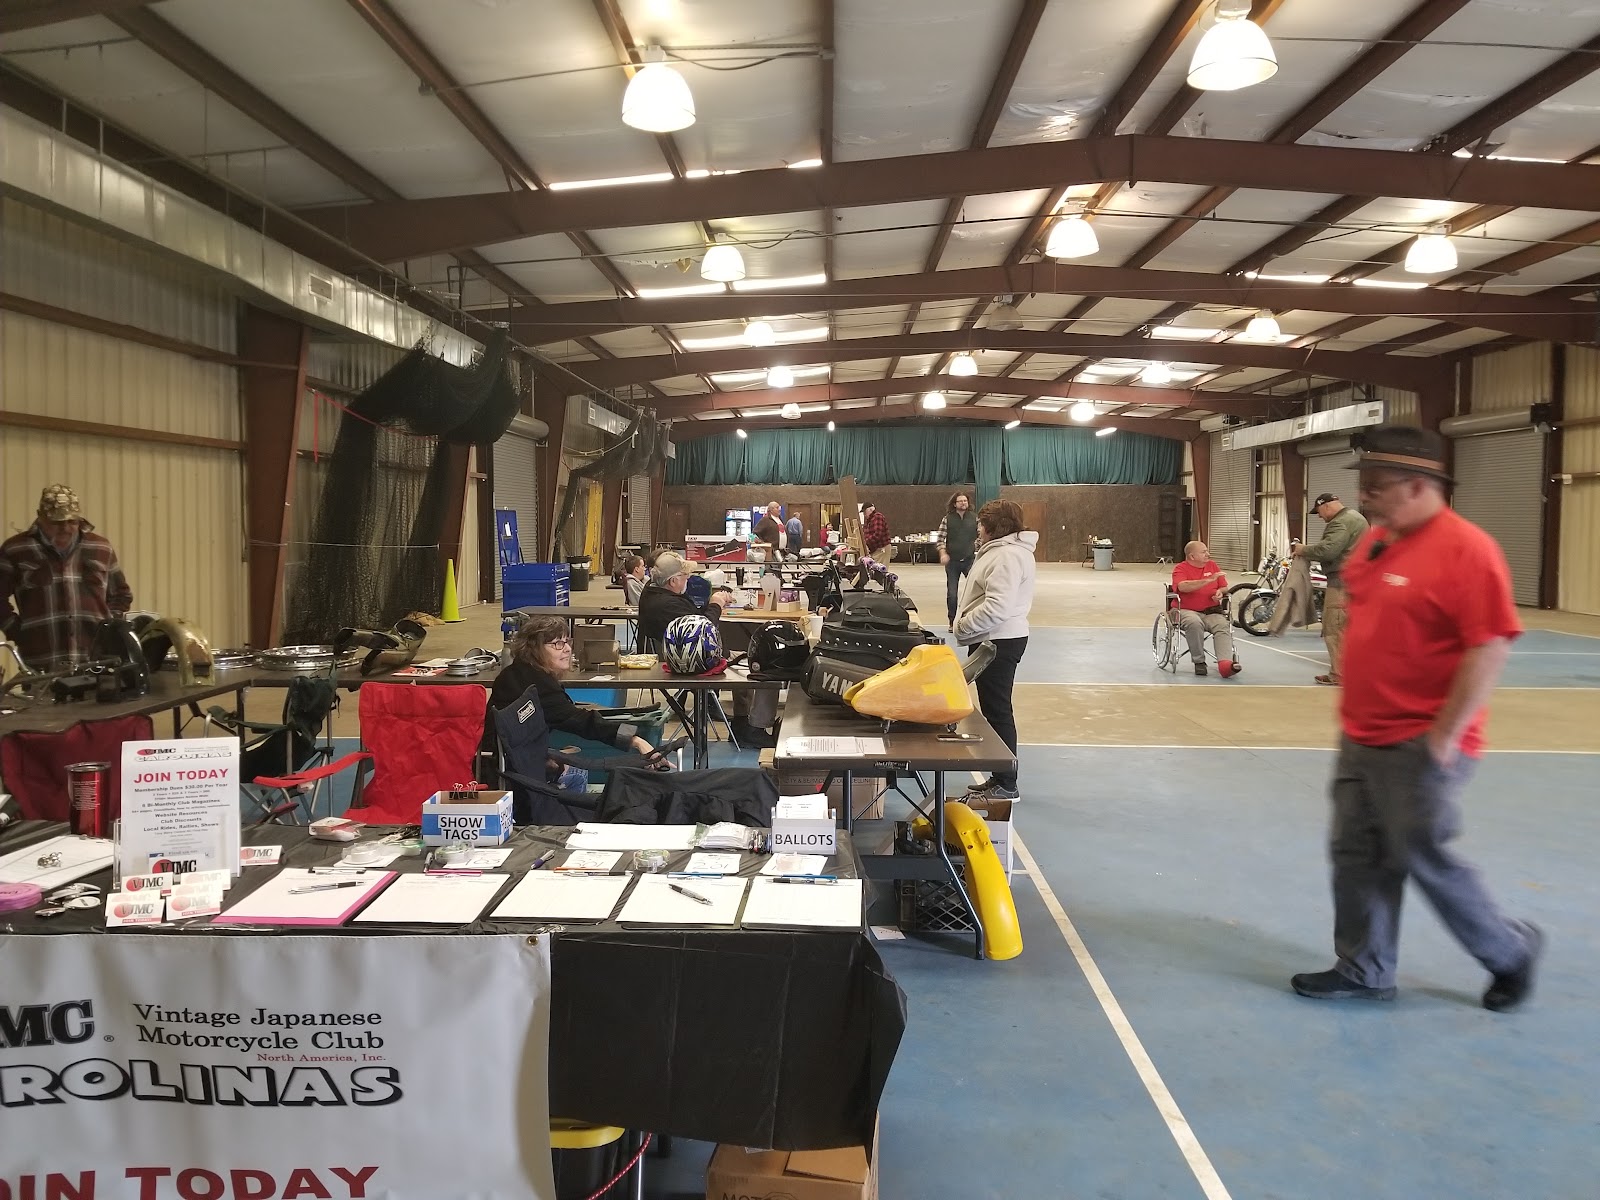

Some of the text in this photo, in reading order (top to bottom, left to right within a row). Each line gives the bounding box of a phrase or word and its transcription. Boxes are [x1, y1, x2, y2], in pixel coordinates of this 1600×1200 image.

[134, 769, 228, 783] JOIN TODAY
[440, 816, 483, 828] SHOW
[443, 829, 478, 840] TAGS
[775, 834, 833, 846] BALLOTS
[160, 860, 197, 875] VJMC
[133, 876, 164, 889] VJMC
[121, 903, 154, 915] VJMC
[133, 1003, 382, 1029] Vintage Japanese
[136, 1024, 384, 1052] Motorcycle Club
[257, 1053, 386, 1063] North America, Inc.
[0, 1057, 403, 1108] ROLINAS
[0, 1166, 379, 1200] IN TODAY
